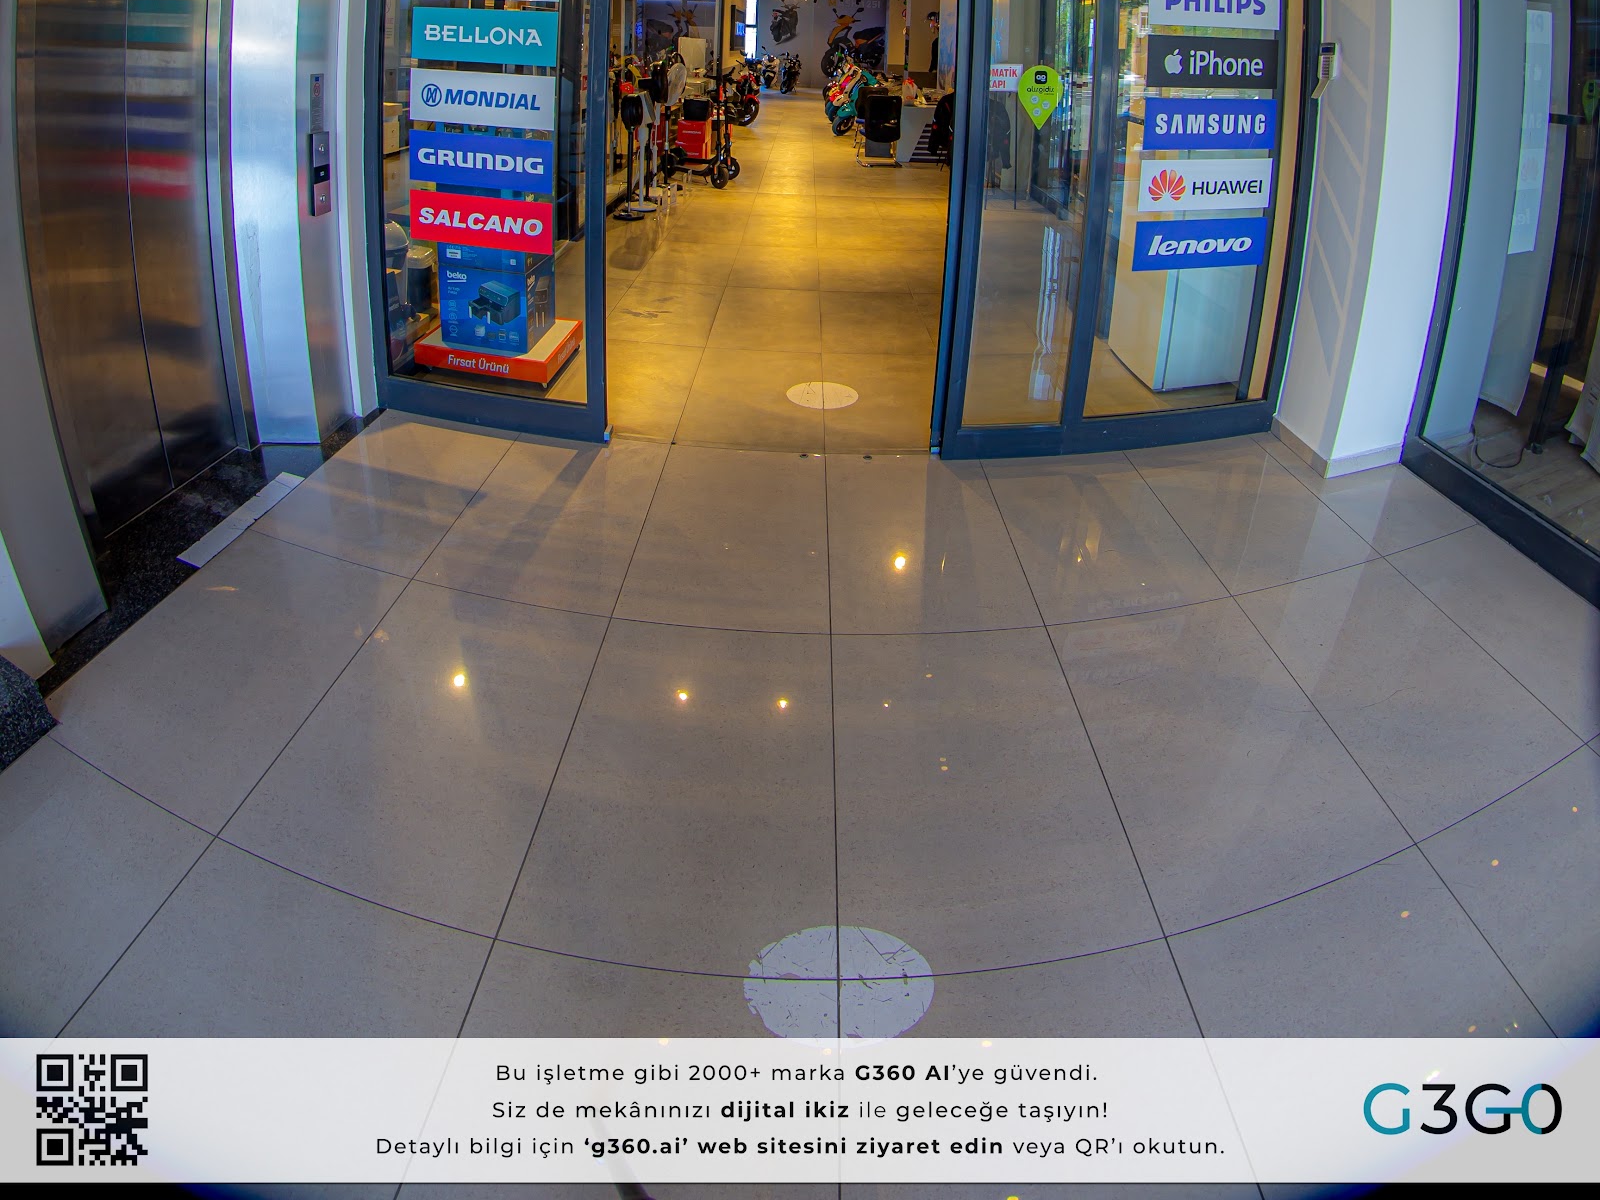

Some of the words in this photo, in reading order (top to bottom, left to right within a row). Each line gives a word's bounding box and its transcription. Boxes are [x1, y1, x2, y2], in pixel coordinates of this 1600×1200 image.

[424, 24, 543, 47] BELLONA
[990, 67, 1018, 78] MATİK
[1189, 50, 1264, 77] iPhone
[989, 80, 1006, 89] API
[444, 88, 541, 112] MONDIAL
[1155, 113, 1267, 135] SAMSUNG
[417, 147, 544, 175] GRUNDIG
[1192, 179, 1263, 196] HUAWEI
[418, 207, 543, 237] SALCANO
[1148, 235, 1253, 256] lenovo
[446, 270, 467, 280] beko
[447, 354, 476, 369] Fırsat
[478, 357, 510, 374] Ürünü
